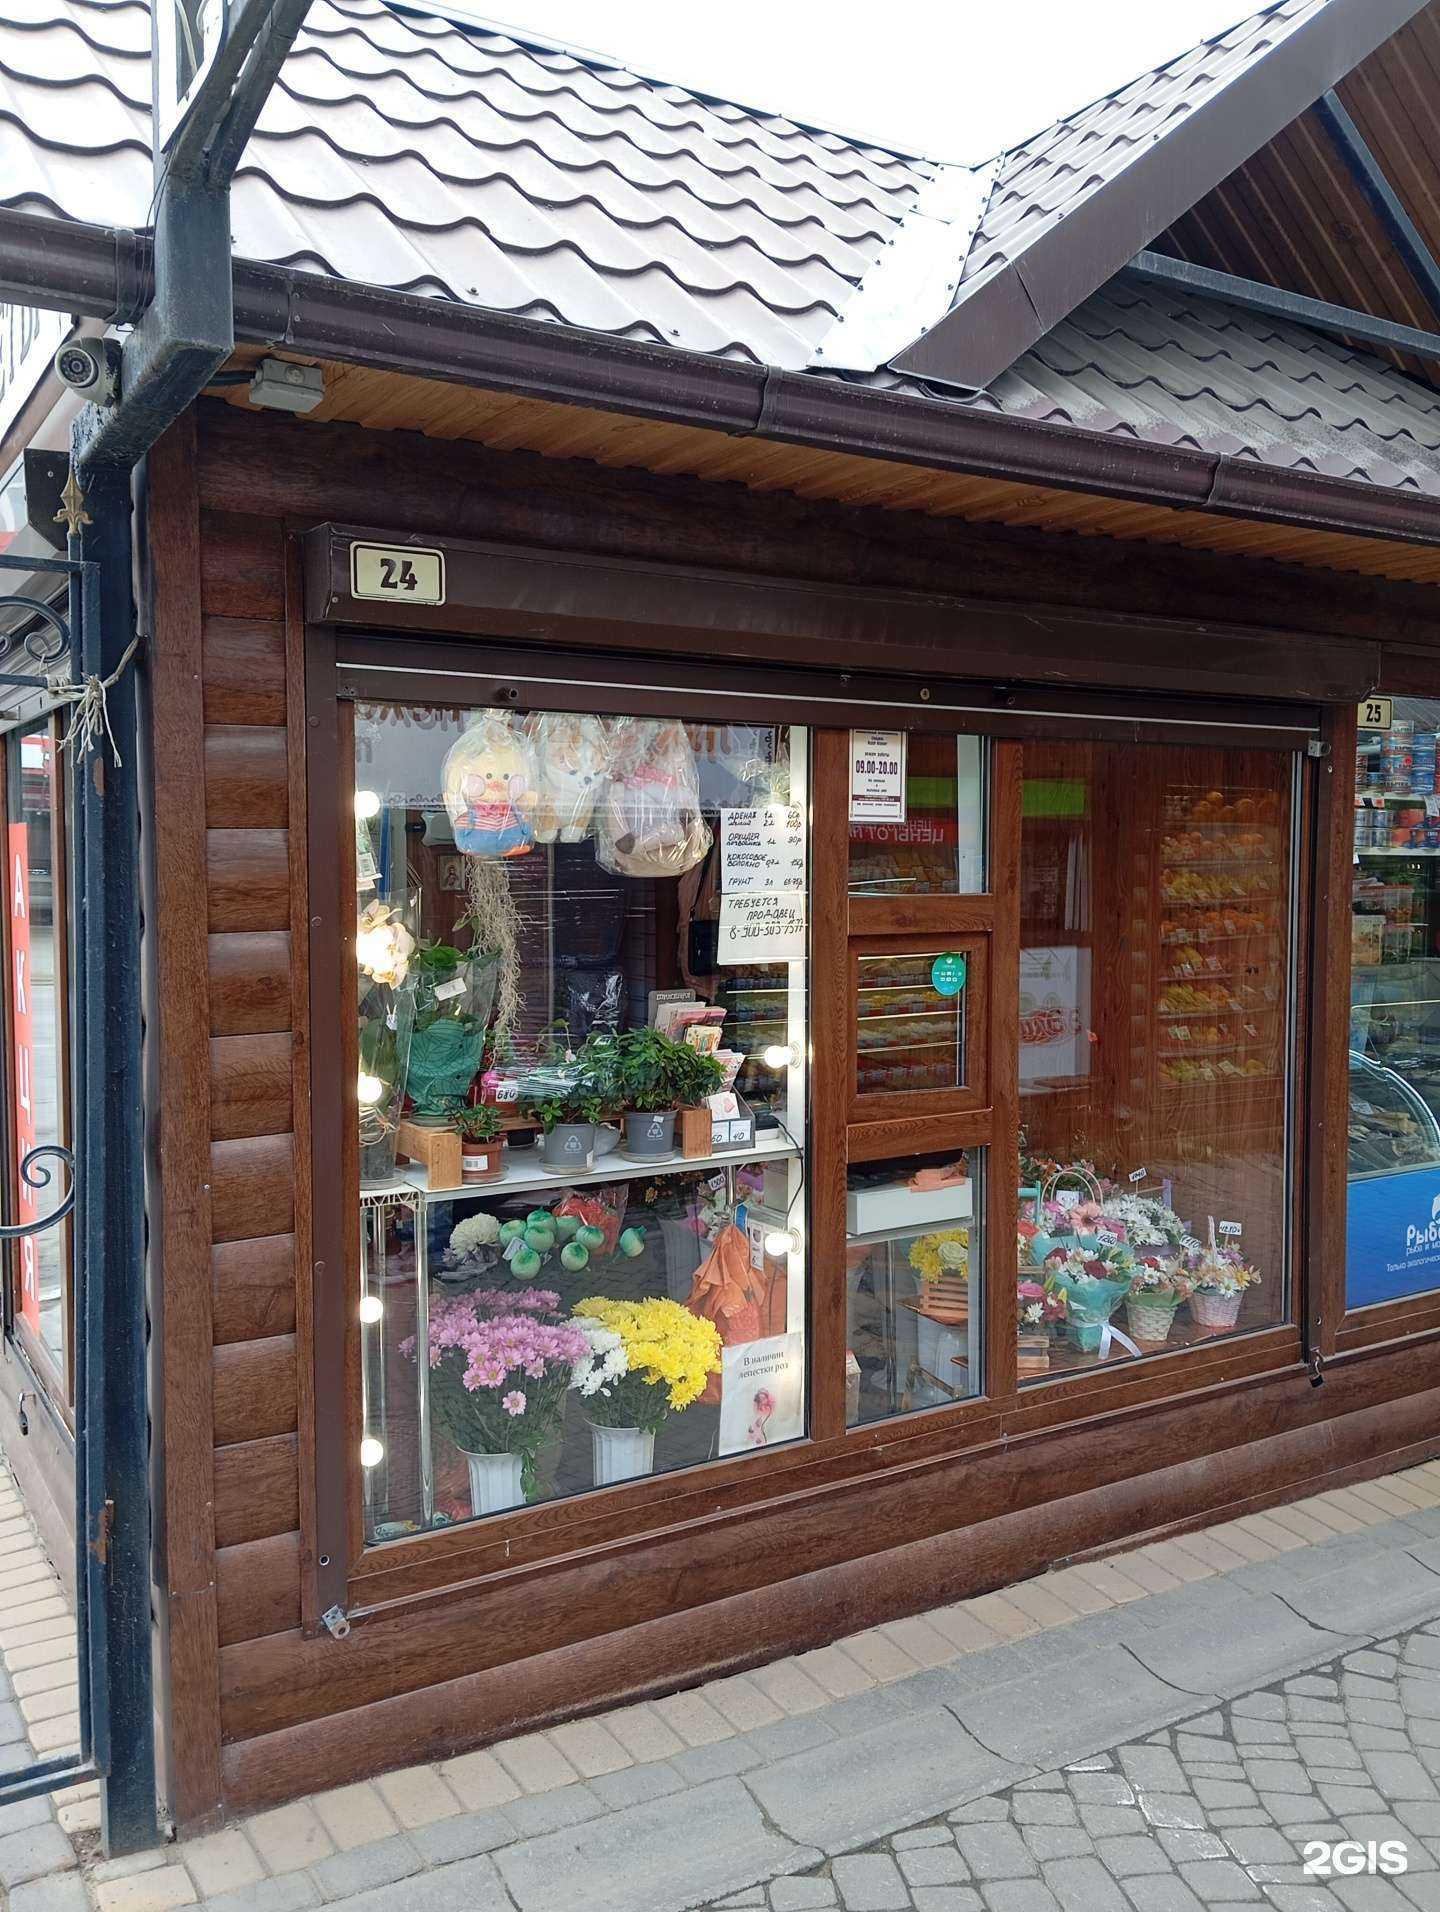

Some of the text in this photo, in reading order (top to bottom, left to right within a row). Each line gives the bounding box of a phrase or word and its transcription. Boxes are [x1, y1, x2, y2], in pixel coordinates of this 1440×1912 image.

[380, 558, 418, 590] 24
[1366, 703, 1381, 723] 25
[855, 759, 898, 776] 09.00-20.00
[728, 877, 753, 886] ГРУНТ
[728, 897, 779, 909] ТРЕБУЕТСЯ
[747, 908, 796, 921] ПРОДАВЕЦ
[743, 1353, 750, 1366] В
